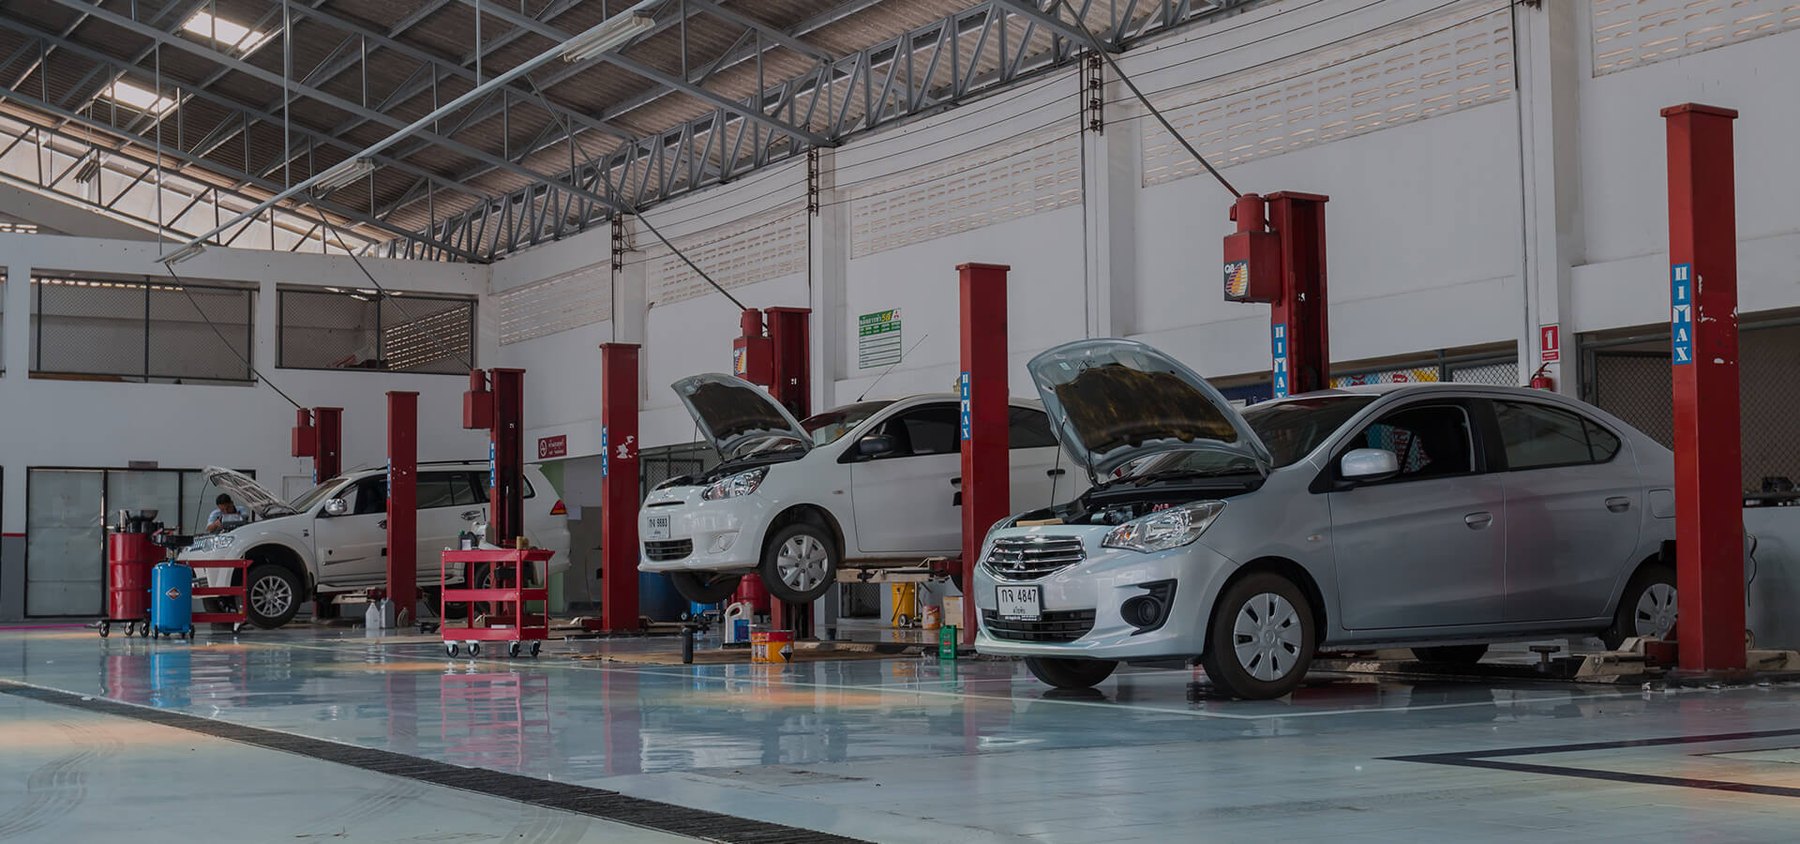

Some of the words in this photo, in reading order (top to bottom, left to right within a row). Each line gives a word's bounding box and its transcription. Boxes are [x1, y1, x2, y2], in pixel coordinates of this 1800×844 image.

[1672, 266, 1691, 361] HIMAX
[961, 374, 971, 439] HIMAX
[1002, 589, 1014, 603] กจ
[1017, 589, 1036, 603] 4847
